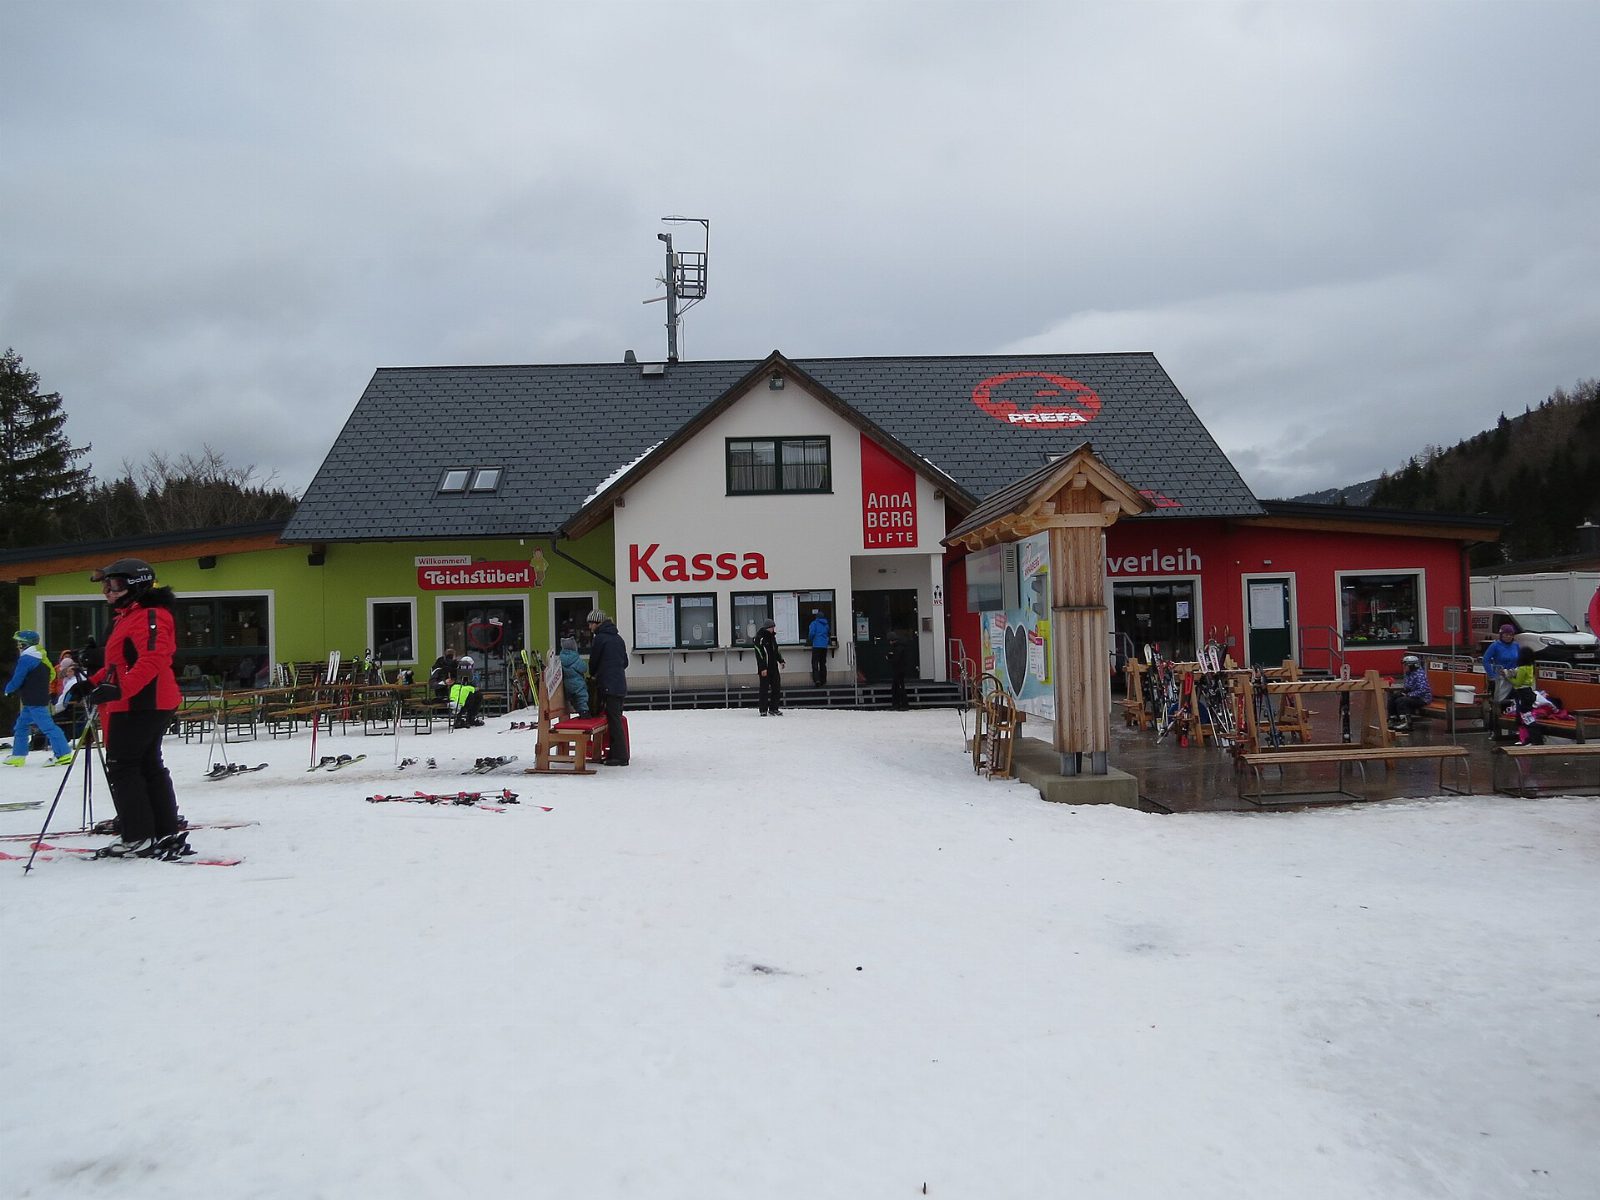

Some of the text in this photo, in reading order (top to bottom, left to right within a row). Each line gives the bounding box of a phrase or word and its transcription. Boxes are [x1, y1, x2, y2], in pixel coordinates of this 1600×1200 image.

[1008, 413, 1087, 423] PREFA
[867, 511, 912, 528] BERG
[868, 532, 912, 543] LIFTE
[418, 557, 467, 565] Willkommen!
[629, 543, 769, 582] Kassa
[424, 568, 530, 585] Teichstüberl
